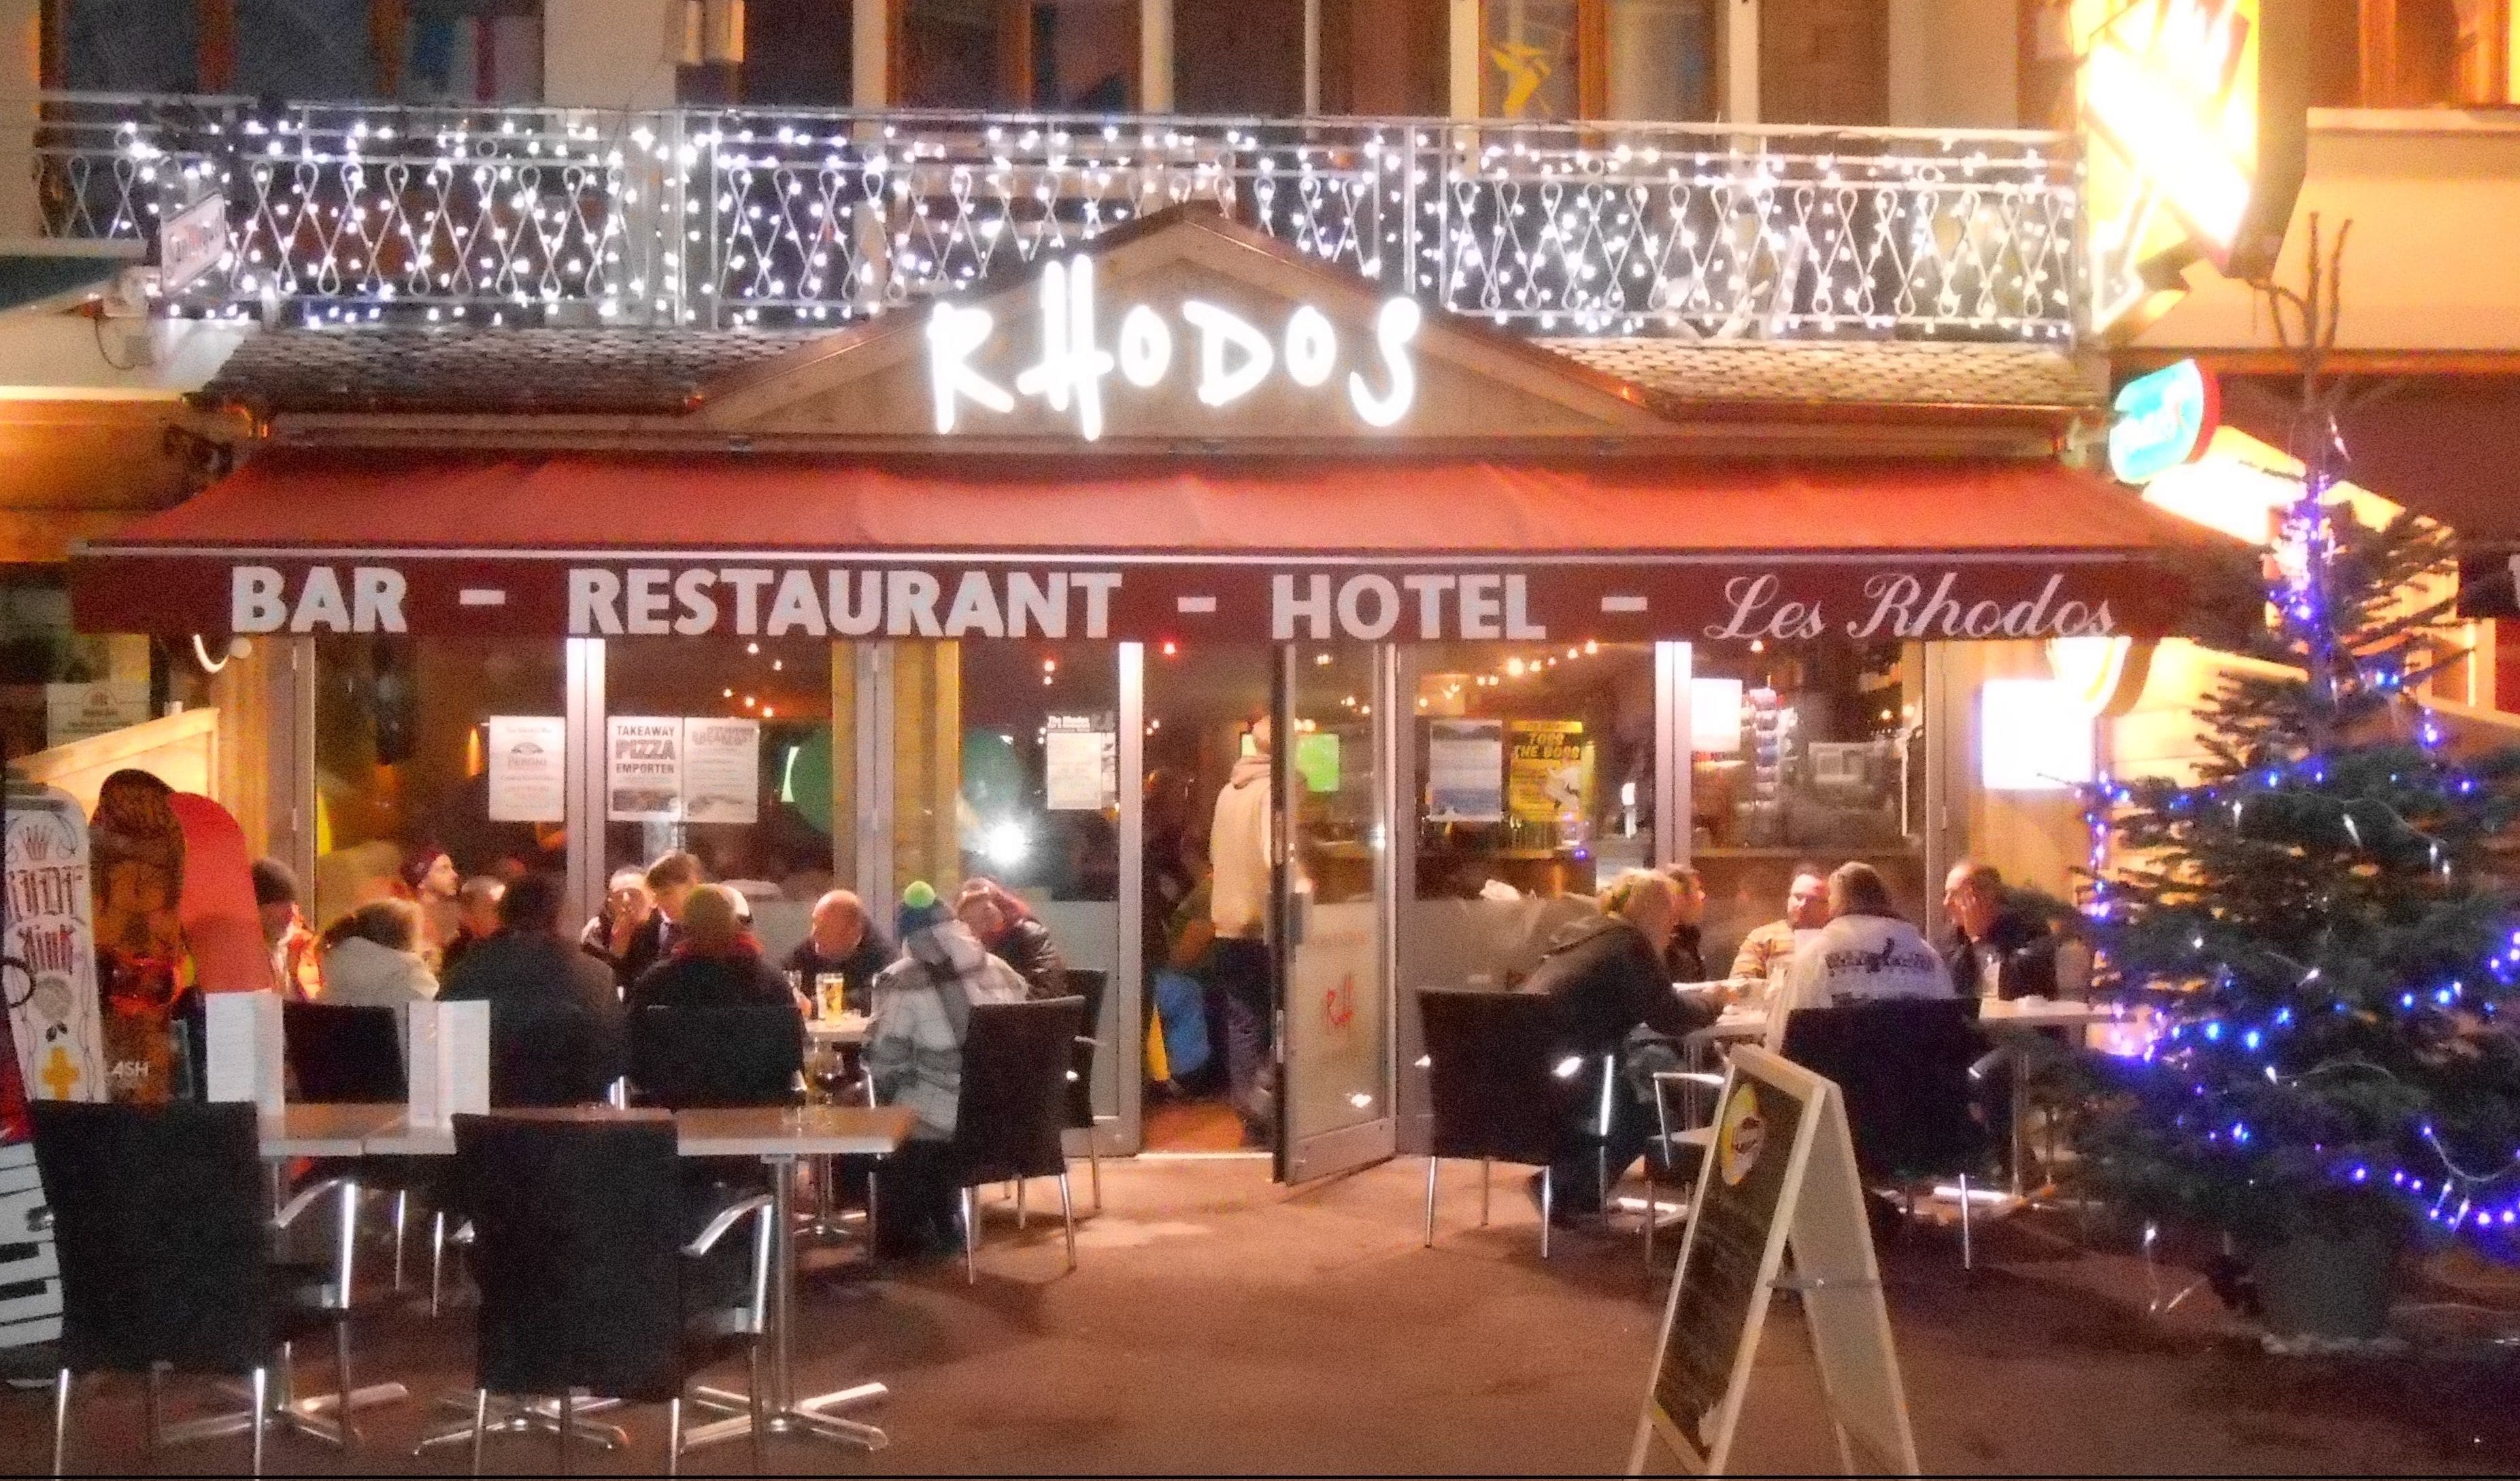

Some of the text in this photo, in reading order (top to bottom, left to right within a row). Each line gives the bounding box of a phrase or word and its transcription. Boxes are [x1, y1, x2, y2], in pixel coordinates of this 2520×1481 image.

[232, 566, 407, 633] BAR
[568, 568, 1123, 638] RESTAURANT
[1272, 574, 1547, 640] HOTEL
[1703, 573, 1826, 640] Les
[1846, 571, 2117, 639] Rhodos
[616, 725, 675, 737] TAKEAWAY
[615, 739, 676, 760] PIZZA
[616, 763, 675, 774] EMPORTER
